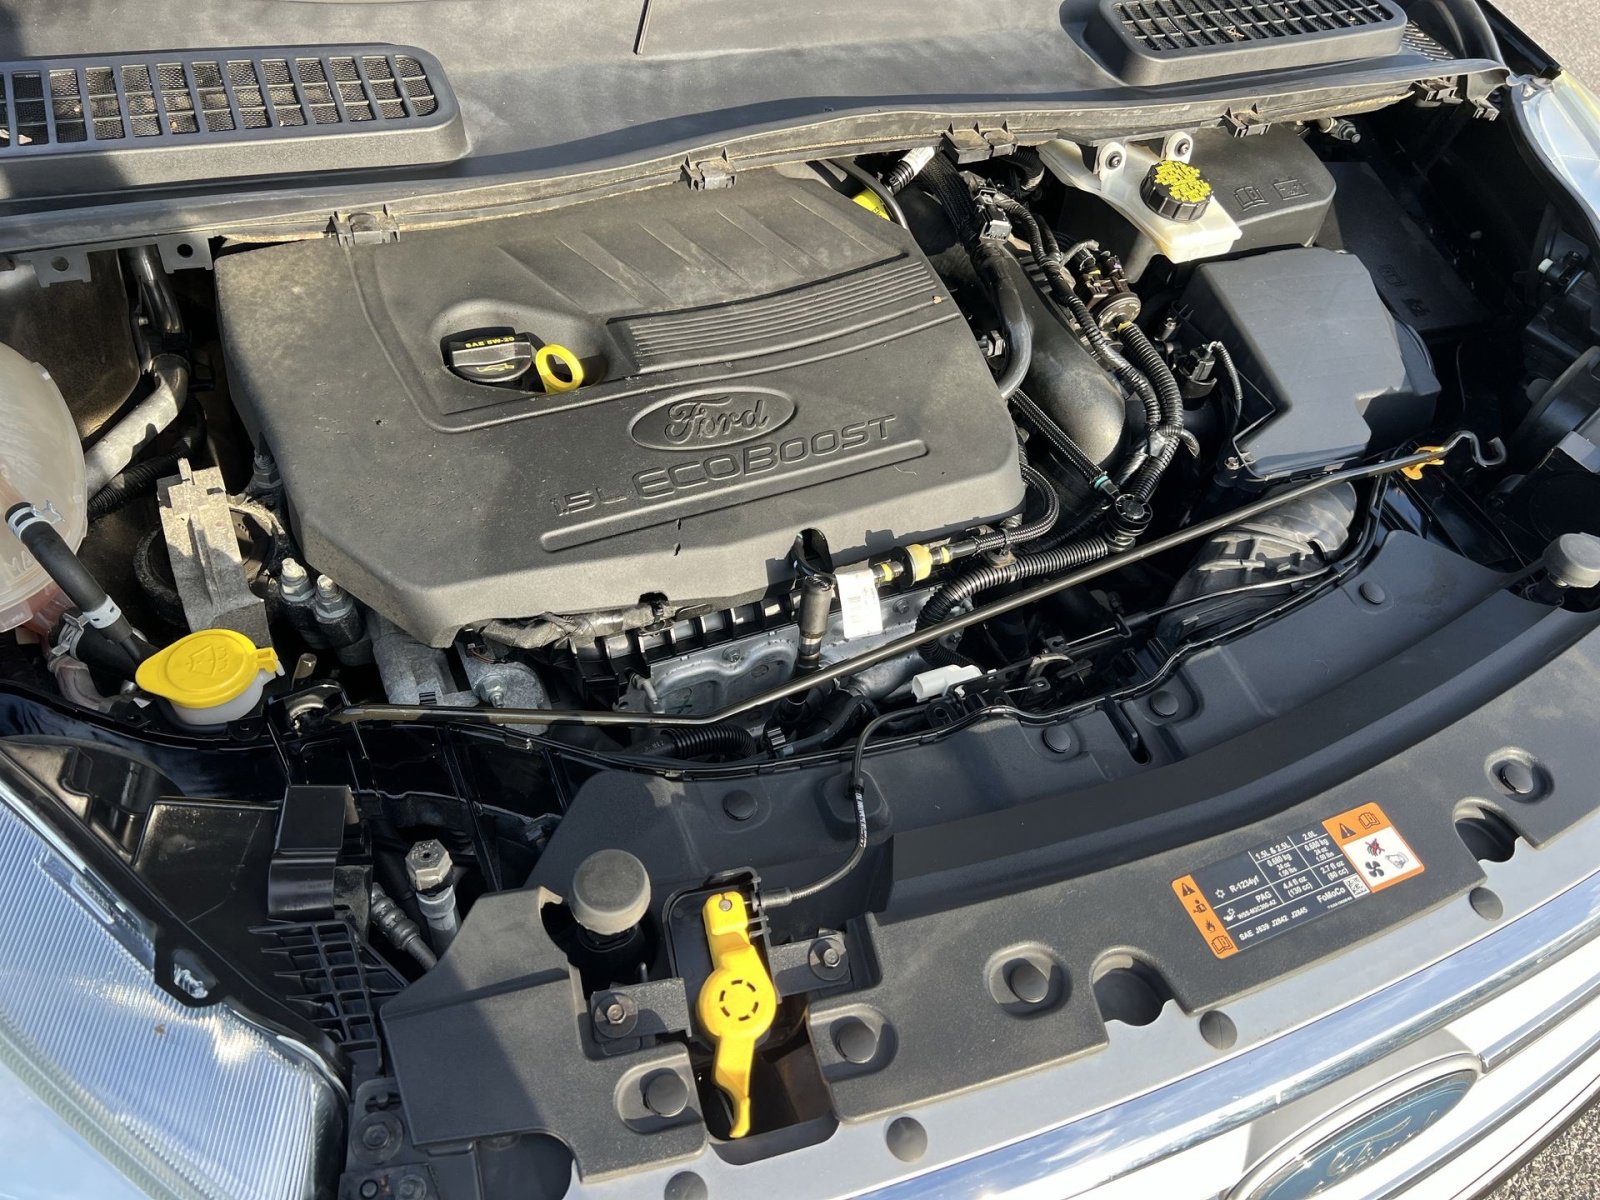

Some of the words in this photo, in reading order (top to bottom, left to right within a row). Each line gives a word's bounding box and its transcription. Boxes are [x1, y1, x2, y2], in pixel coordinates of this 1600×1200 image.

[487, 336, 515, 345] 5W-20
[665, 395, 770, 444] Ford
[551, 487, 628, 516] 1.5L
[632, 414, 897, 500] ECOBOOST
[4, 549, 37, 580] MA
[1302, 830, 1318, 841] 2.0L
[1319, 838, 1330, 847] kg
[1255, 849, 1270, 860] 1.5L
[1270, 847, 1276, 855] &
[1276, 842, 1291, 852] 2.5L
[1283, 853, 1293, 862] kg
[1320, 865, 1330, 875] 2.7
[1338, 867, 1349, 876] cc)
[1229, 875, 1259, 893] R-1234yf
[1282, 880, 1293, 890] 4.4
[1287, 885, 1302, 898] (130
[1302, 882, 1314, 891] cc)
[1255, 891, 1272, 903] PAG
[1316, 887, 1346, 903] FoMoCo
[1239, 929, 1254, 941] SAE
